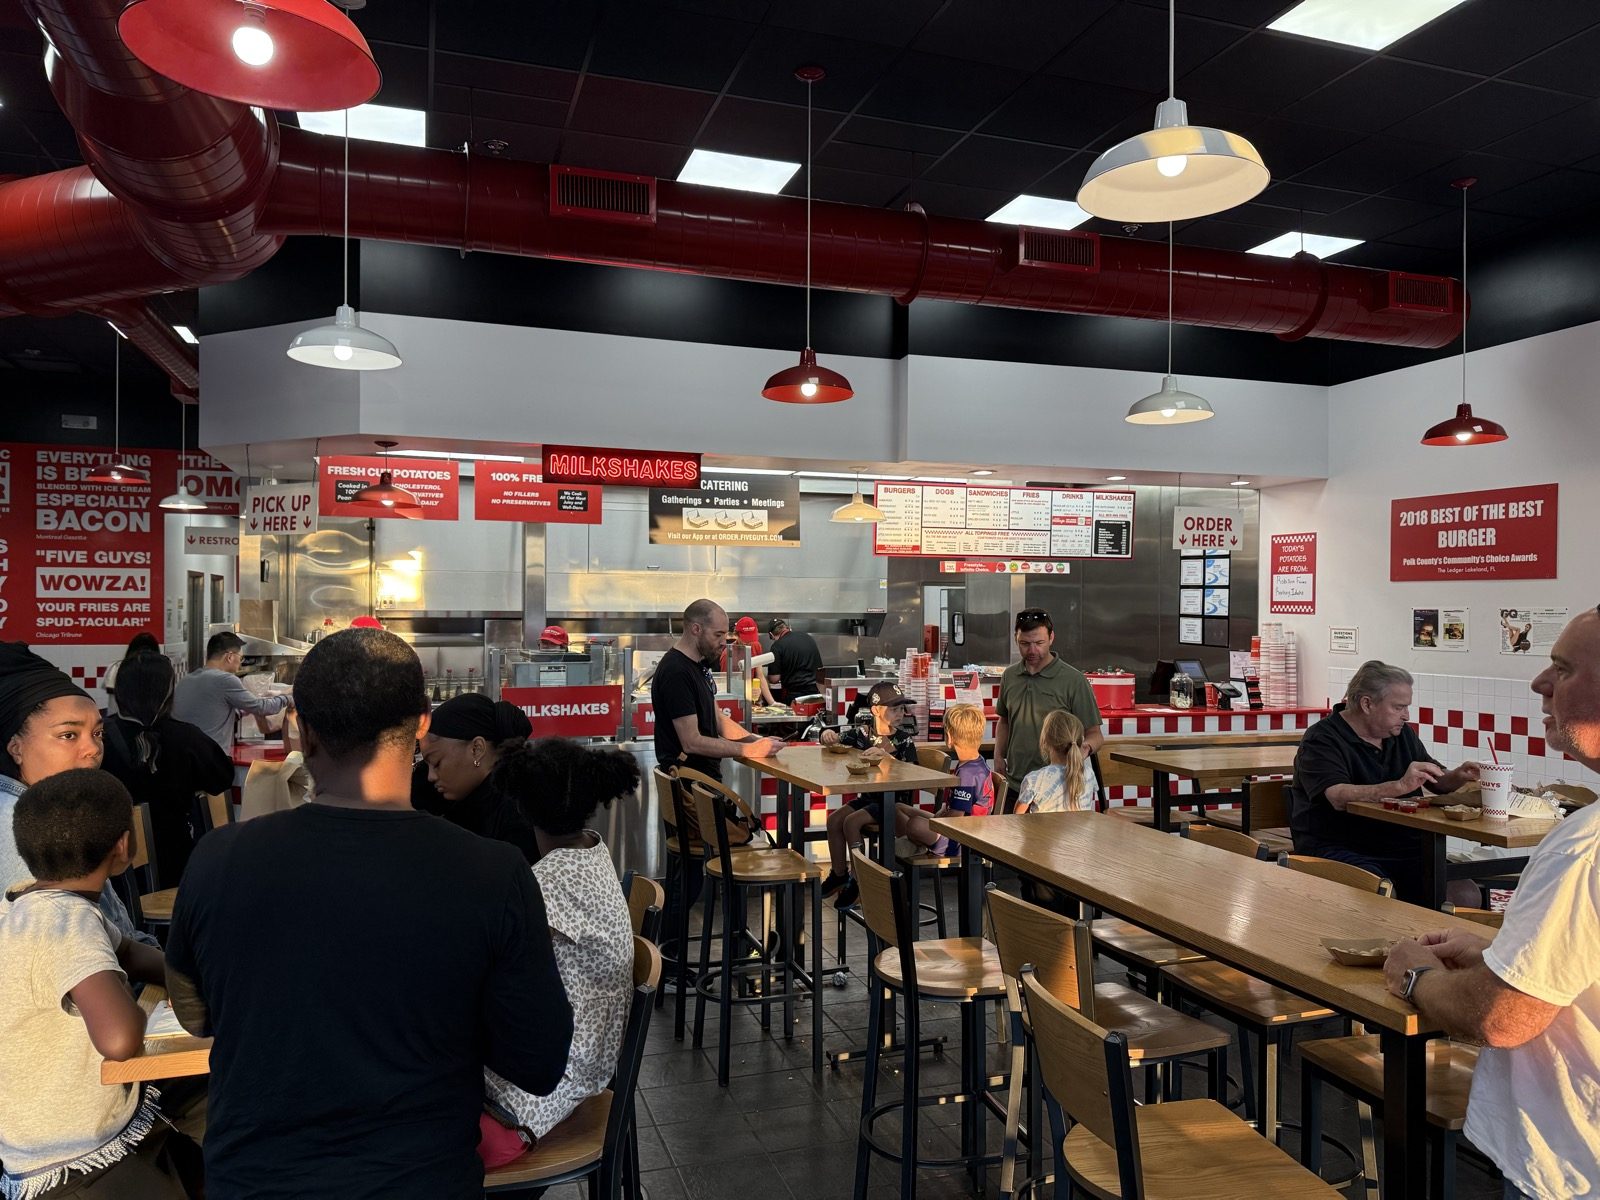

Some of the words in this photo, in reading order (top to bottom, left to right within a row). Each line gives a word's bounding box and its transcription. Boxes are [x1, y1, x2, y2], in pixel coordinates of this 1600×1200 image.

[36, 466, 58, 480] IS
[327, 465, 365, 476] FRESH
[394, 469, 451, 481] POTATOES
[550, 454, 698, 480] MILKSHAKES
[491, 472, 519, 482] 100%
[181, 475, 240, 497] OM
[700, 480, 748, 492] CATERING
[36, 493, 150, 508] ESPECIALLY
[252, 496, 285, 513] PICK
[292, 495, 311, 511] UP
[662, 495, 702, 506] Gatherings
[714, 497, 740, 506] Parties
[752, 498, 784, 508] Meetings
[1400, 510, 1428, 527] 2018
[1431, 508, 1462, 524] BEST
[1463, 505, 1479, 522] OF
[1482, 503, 1505, 520] THE
[1509, 499, 1544, 518] BEST
[36, 508, 150, 533] BACON
[263, 516, 297, 532] HERE
[1184, 517, 1232, 532] ORDER
[692, 533, 703, 542] App
[719, 533, 783, 542] ORDER.FIVEGUYS.COM
[1192, 534, 1224, 547] HERE
[1438, 527, 1496, 548] BURGER
[94, 552, 151, 564] GUYS!
[1403, 558, 1416, 566] Polk
[1416, 557, 1442, 566] County's
[1443, 555, 1484, 565] Community's
[1486, 554, 1510, 563] Choice
[1511, 553, 1537, 562] Awards
[1290, 565, 1308, 573] FROM:
[40, 575, 146, 591] WOWZA!
[36, 603, 75, 612] YOUR
[80, 603, 119, 612] FRIES
[122, 603, 150, 612] ARE
[1500, 609, 1518, 619] GQ
[954, 789, 971, 799] beko
